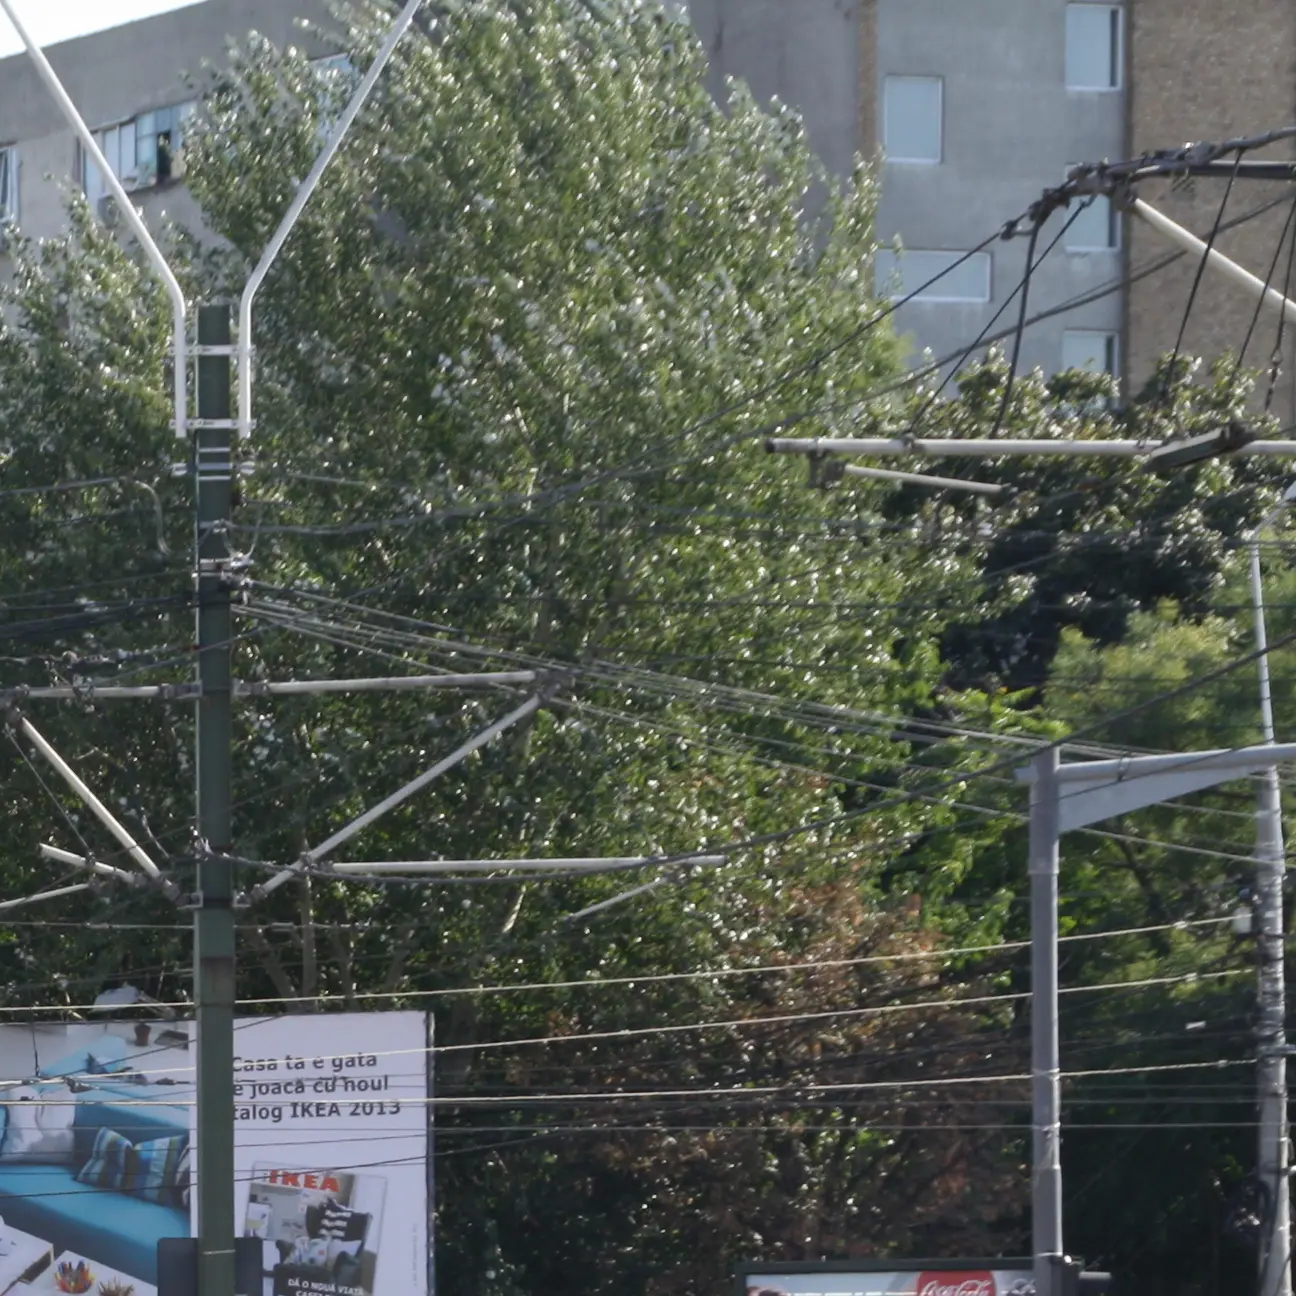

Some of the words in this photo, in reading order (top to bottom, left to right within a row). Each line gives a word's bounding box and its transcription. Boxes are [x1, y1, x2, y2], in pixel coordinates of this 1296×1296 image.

[233, 1056, 278, 1072] Casa
[286, 1054, 306, 1071] ta
[312, 1057, 325, 1070] e
[331, 1052, 378, 1073] gata
[313, 1079, 336, 1094] cu
[343, 1074, 389, 1093] noul
[233, 1103, 283, 1123] talog
[290, 1102, 341, 1119] IKEA
[348, 1100, 402, 1117] 2013
[268, 1169, 341, 1193] IKEA
